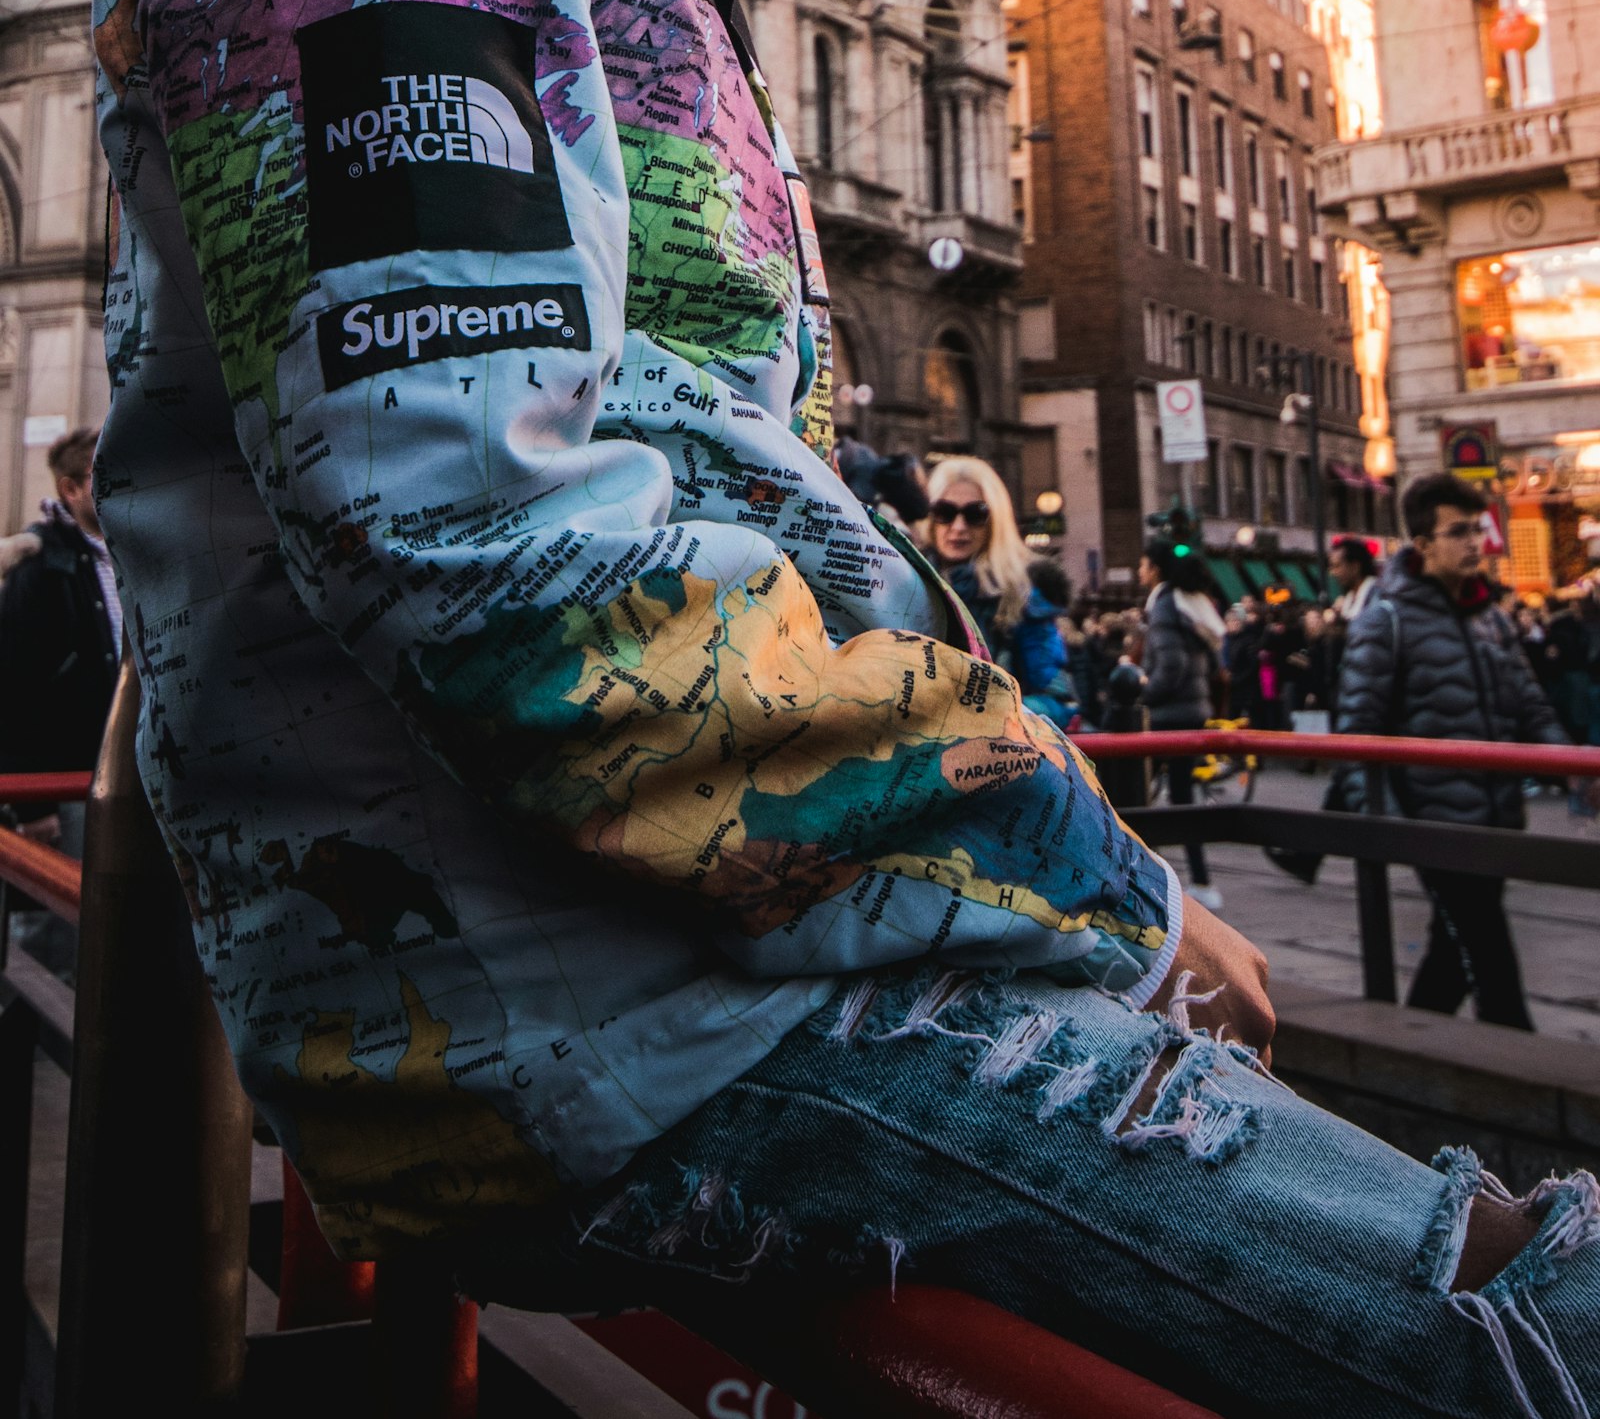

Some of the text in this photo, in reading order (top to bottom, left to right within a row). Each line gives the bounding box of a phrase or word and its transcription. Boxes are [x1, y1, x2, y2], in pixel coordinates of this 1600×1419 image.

[547, 43, 572, 60] Bay
[603, 42, 659, 65] Edmonton
[380, 74, 465, 104] THE
[324, 102, 468, 154] NORTH
[643, 105, 680, 126] Regina
[364, 133, 473, 174] FACE
[649, 156, 697, 180] Bismarck
[628, 188, 693, 212] Minneapolis
[627, 290, 657, 305] Louis
[651, 273, 716, 296] Indianapolis
[685, 291, 710, 304] Ohio
[341, 297, 568, 359] Supreme
[676, 309, 724, 327] Nashville
[733, 346, 780, 364] Columbia
[644, 366, 668, 384] of
[713, 354, 757, 386] Savannah
[672, 383, 721, 417] Gulf
[731, 407, 764, 422] BAHAMAS
[770, 467, 804, 483] de Cuba
[353, 491, 382, 512] Cuba
[751, 500, 782, 515] Santo
[805, 498, 823, 513] San
[391, 510, 420, 529] San
[737, 509, 778, 528] Domingo
[781, 530, 800, 540] AND
[830, 539, 877, 554] ANTIGUA AND
[512, 527, 577, 594] Port of Spain
[619, 528, 667, 584] Paramaribo
[670, 535, 702, 581] Cayenne
[581, 541, 642, 609] Georgetown
[755, 564, 783, 597] Belem
[144, 609, 191, 639] PHILIPPINE
[617, 595, 651, 646] SURINAME
[178, 676, 203, 695] SEA
[610, 667, 651, 695] Branco
[676, 663, 716, 715] Manaus
[896, 669, 916, 713] Cuiaba
[959, 662, 980, 707] Campo
[972, 661, 992, 705] Grande
[1026, 792, 1058, 847] Tucuman
[1051, 786, 1077, 847] Corrientes
[696, 822, 730, 867] Branco
[772, 839, 803, 881] Cuzco
[850, 873, 877, 906] Arica
[257, 1029, 281, 1048] SEA
[350, 1034, 410, 1058] Carpentaria
